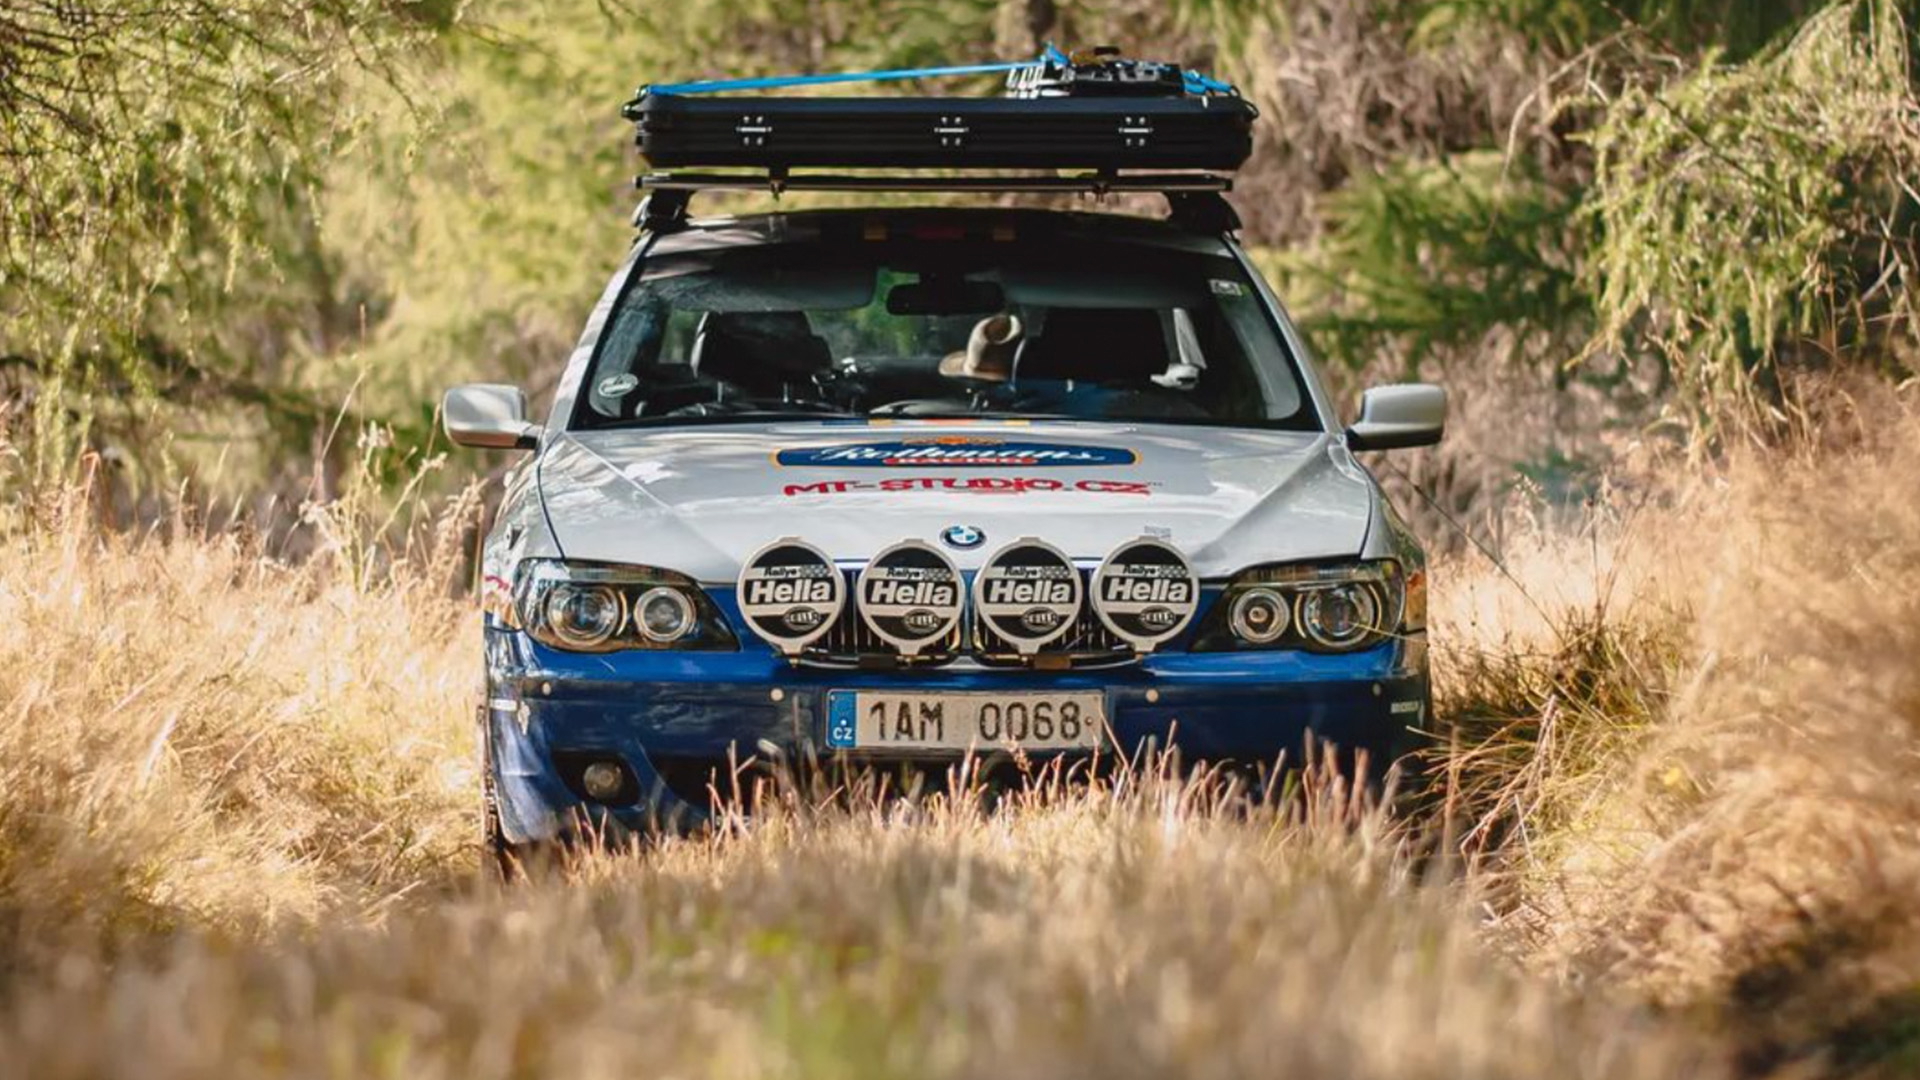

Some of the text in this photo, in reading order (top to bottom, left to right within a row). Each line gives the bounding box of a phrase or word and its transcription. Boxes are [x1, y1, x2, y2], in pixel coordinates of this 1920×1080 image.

[811, 447, 1105, 462] Rothmans
[764, 566, 798, 579] Rallye
[750, 578, 831, 604] Hella
[871, 580, 953, 606] Hella
[989, 580, 1071, 604] Hella
[1107, 577, 1188, 602] Hella
[870, 701, 1081, 741] 1AM 0068
[833, 727, 853, 740] CZ
